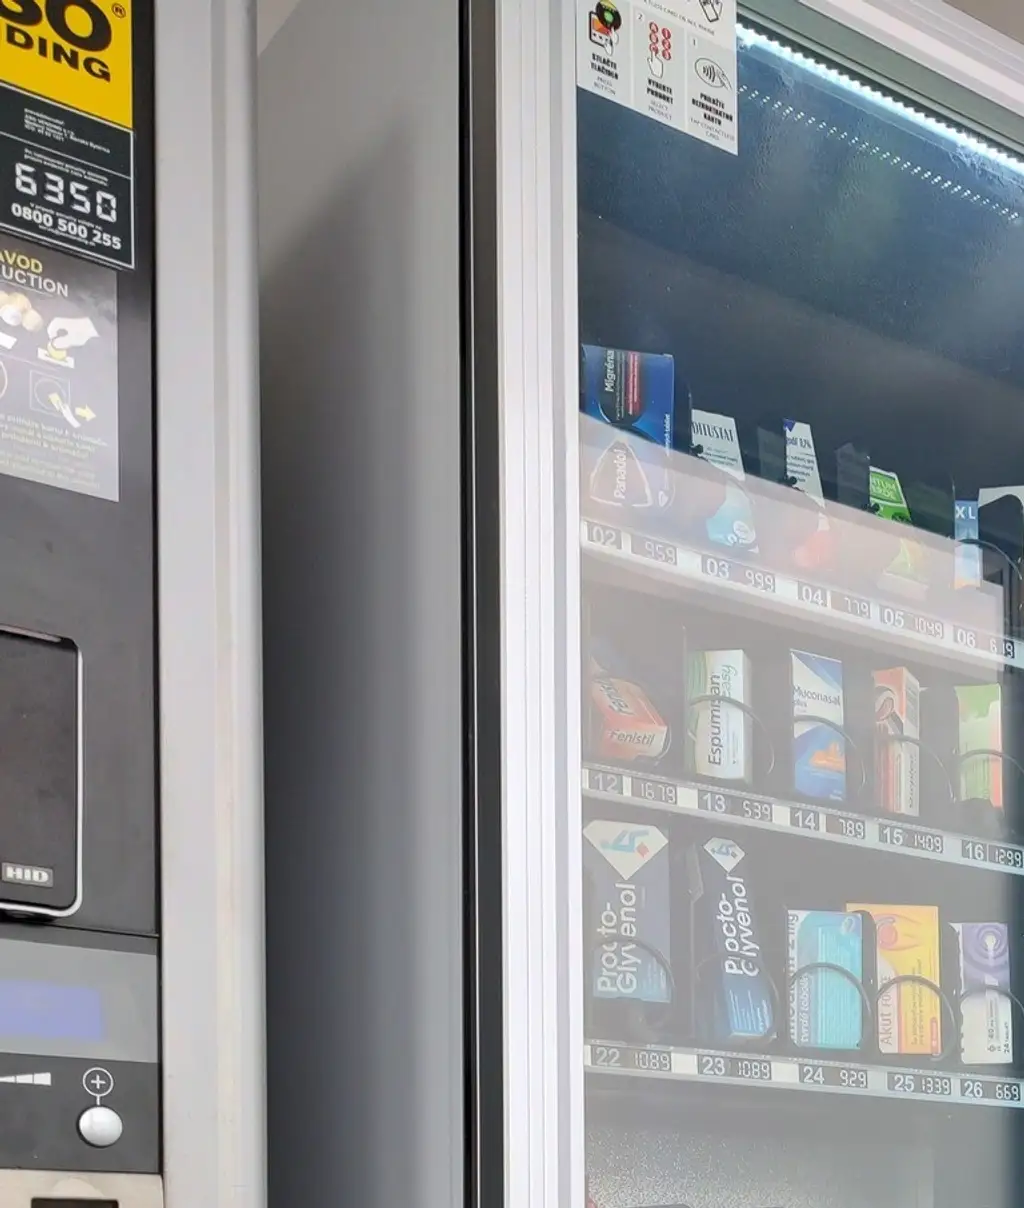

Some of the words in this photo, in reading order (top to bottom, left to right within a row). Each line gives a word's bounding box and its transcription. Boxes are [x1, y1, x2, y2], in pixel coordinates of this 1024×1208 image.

[15, 162, 117, 223] 6350
[11, 202, 54, 228] 0800
[57, 217, 88, 240] 500
[91, 228, 122, 251] 255
[613, 449, 627, 499] Panadol
[592, 526, 616, 546] 02
[706, 557, 729, 578] 03
[745, 569, 774, 592] 999
[801, 586, 823, 607] 04
[884, 608, 905, 627] 05
[957, 629, 976, 648] 06
[595, 772, 618, 794] 12
[703, 792, 726, 813] 13
[743, 800, 771, 821] 539
[794, 811, 816, 832] 14
[838, 819, 865, 840] 789
[882, 827, 904, 847] 15
[914, 834, 942, 854] 1409
[964, 843, 985, 861] 16
[995, 850, 1022, 867] 1299
[6, 866, 49, 882] HID
[716, 892, 743, 975] Pocto-
[596, 1047, 620, 1067] 22
[634, 1051, 670, 1071] 1089
[702, 1056, 725, 1076] 23
[738, 1061, 771, 1079] 1089
[803, 1066, 825, 1084] 24
[840, 1070, 867, 1088] 929
[894, 1075, 915, 1092] 25
[922, 1078, 951, 1095] 1339
[964, 1081, 983, 1098] 26
[996, 1084, 1020, 1101] 669
